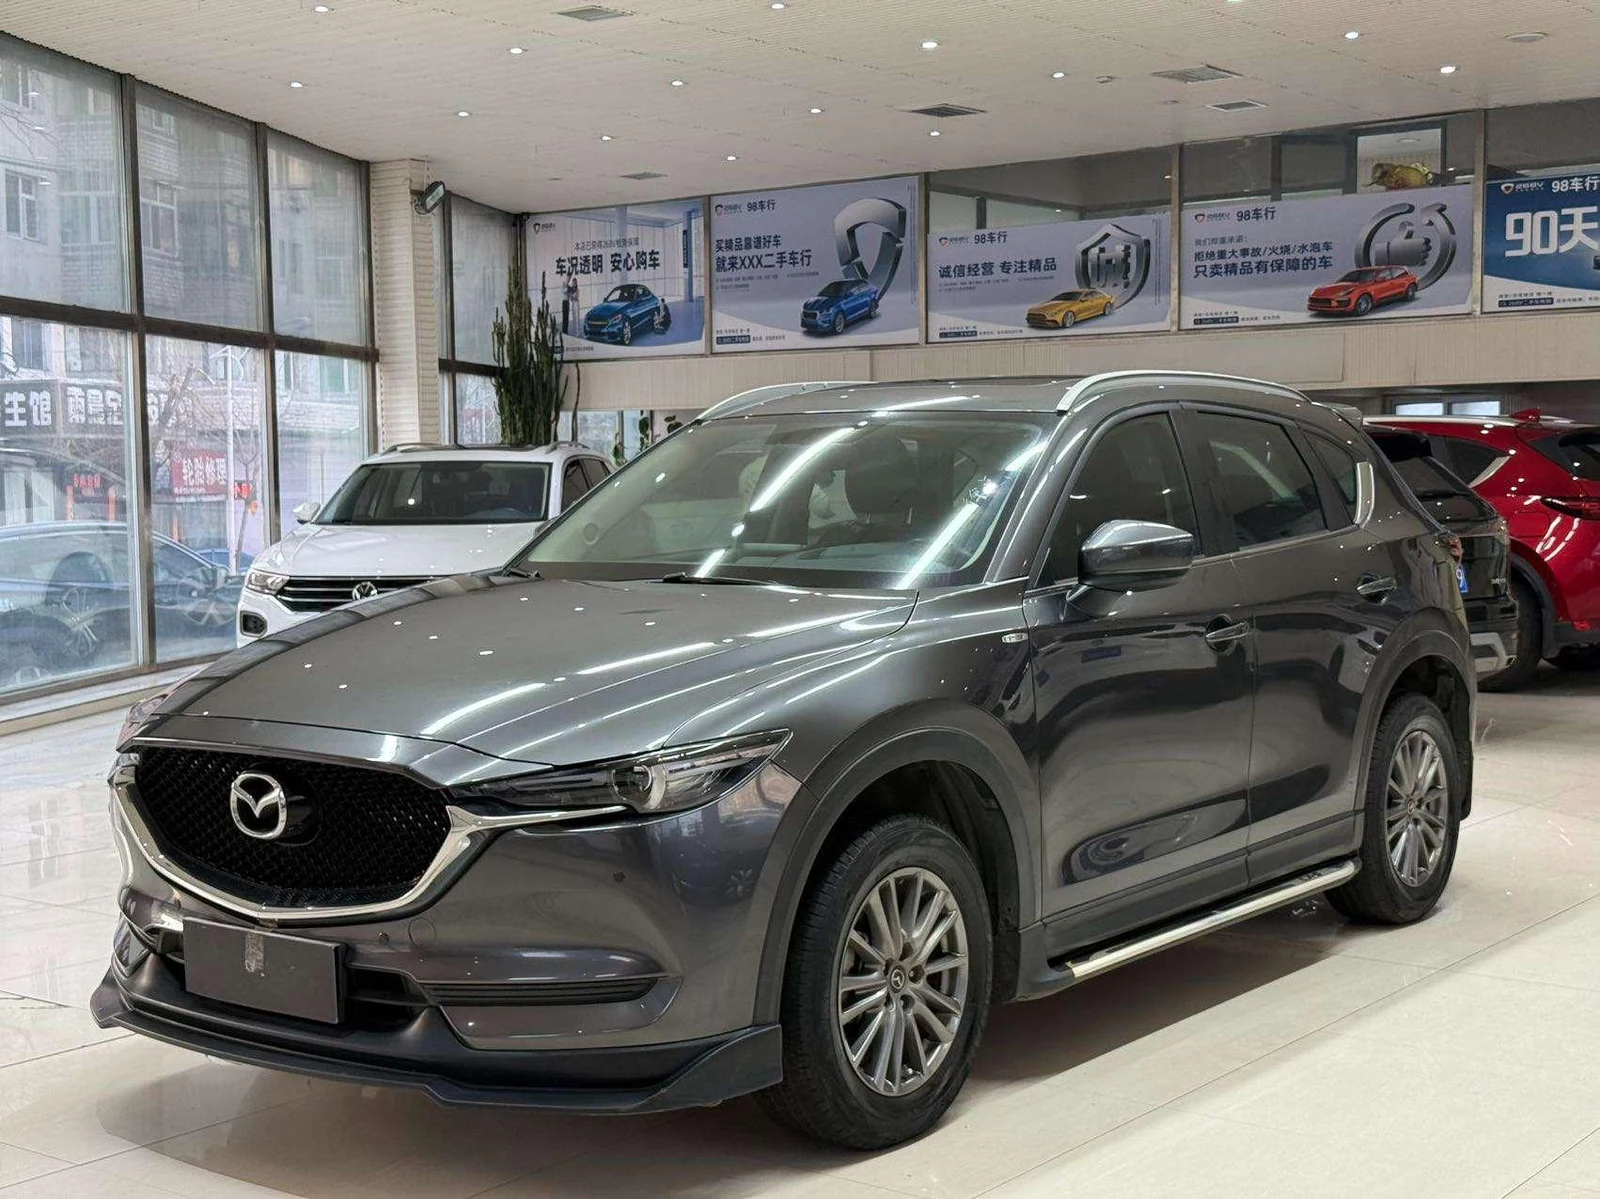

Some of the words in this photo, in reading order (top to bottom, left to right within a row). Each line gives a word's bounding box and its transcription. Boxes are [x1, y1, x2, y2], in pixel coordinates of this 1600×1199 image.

[1551, 176, 1600, 193] 98车行
[746, 199, 776, 212] 98车行
[1236, 206, 1276, 222] 98车行
[974, 231, 1008, 245] 98车行
[1505, 206, 1599, 257] 90天
[715, 234, 782, 253] 买精品靠谱好车
[1194, 241, 1333, 262] 拒绝重大事故/火烧/水泡车
[555, 254, 603, 276] 车况透明
[610, 249, 660, 272] 安心购车
[715, 249, 812, 273] 就来XXX二手车行
[938, 261, 994, 279] 诚信经营
[999, 257, 1057, 275] 专注精品
[1193, 255, 1333, 278] 只卖精品有保障的车
[0, 390, 52, 427] 生馆
[183, 456, 227, 486] 轮胎修理
